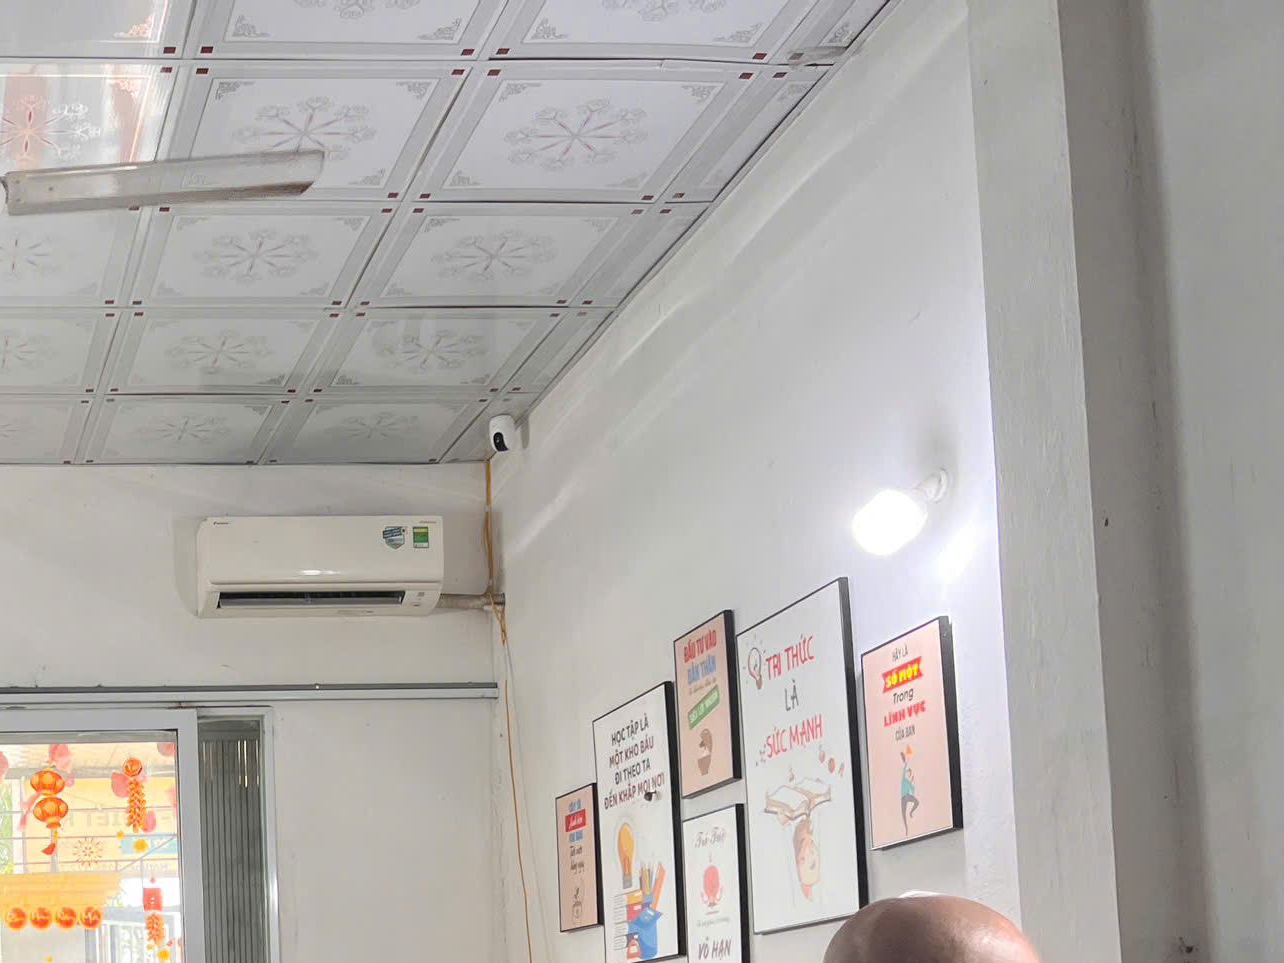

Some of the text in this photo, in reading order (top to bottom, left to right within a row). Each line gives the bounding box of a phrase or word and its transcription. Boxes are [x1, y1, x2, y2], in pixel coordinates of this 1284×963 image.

[784, 634, 814, 672] THỨC
[785, 679, 799, 711] LÀ
[893, 688, 914, 704] Trong
[612, 713, 649, 747] HỌC TẬP LÀ
[766, 713, 823, 758] SỨC MẠNH
[609, 734, 654, 769] MỘT KHO BÁU
[615, 758, 651, 785] ĐI THEO TA
[604, 789, 617, 810] ĐẾN
[698, 936, 732, 960] VÔ HẠN
